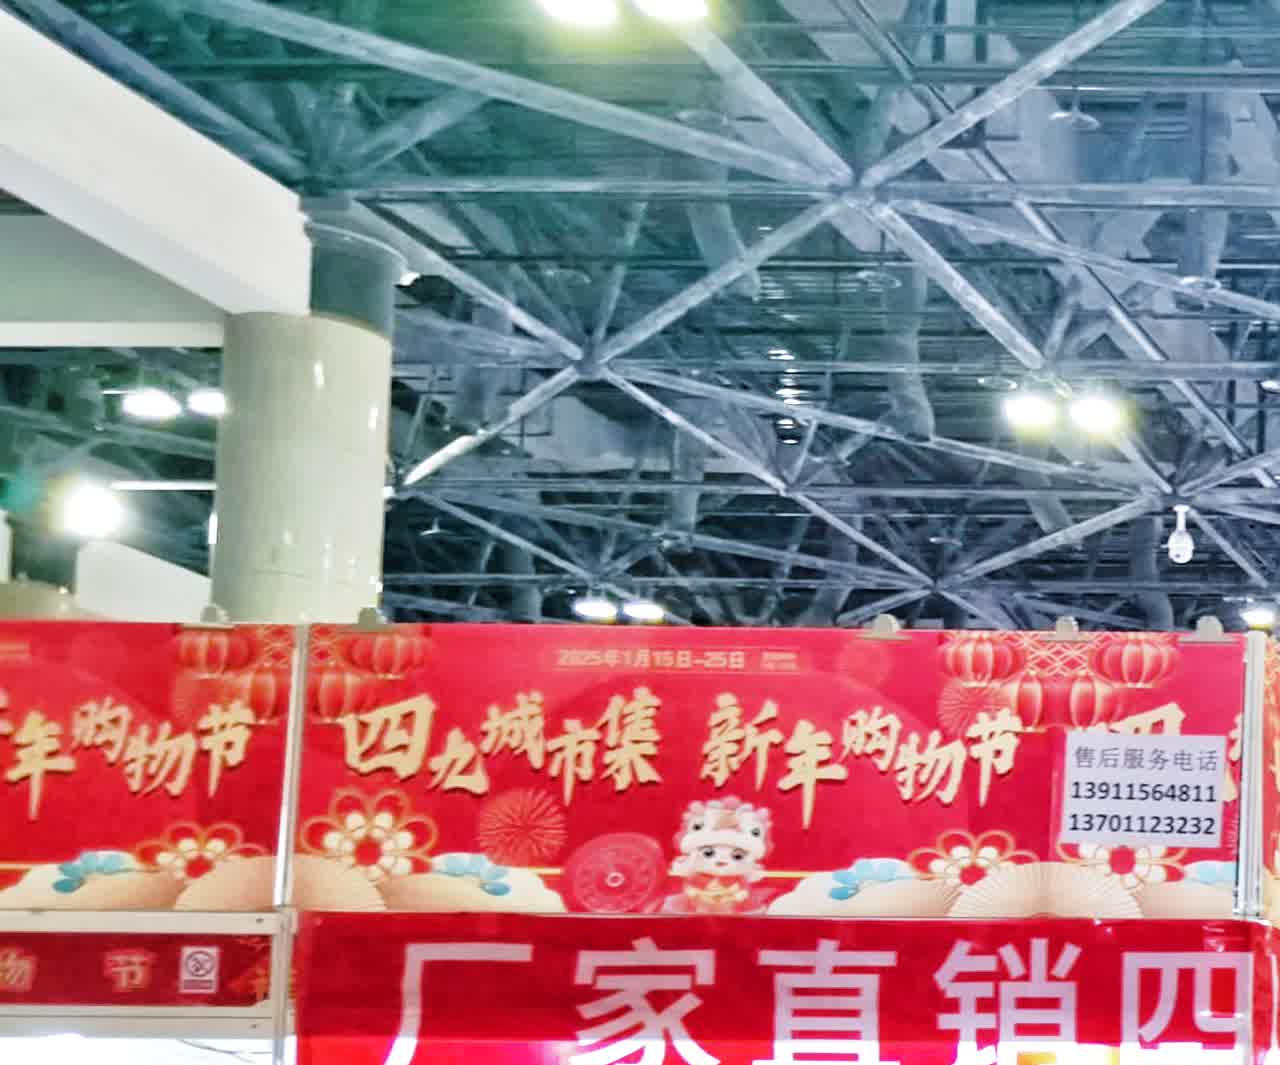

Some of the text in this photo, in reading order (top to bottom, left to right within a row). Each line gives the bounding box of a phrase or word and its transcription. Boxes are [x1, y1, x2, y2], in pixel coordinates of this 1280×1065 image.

[0, 694, 255, 821] 年购物节
[343, 688, 663, 806] 四九城市集
[701, 693, 1023, 829] 新年购物节
[1073, 746, 1219, 772] 售后服务电话
[1071, 781, 1217, 803] 13911564811
[1068, 813, 1217, 836] 13701123232
